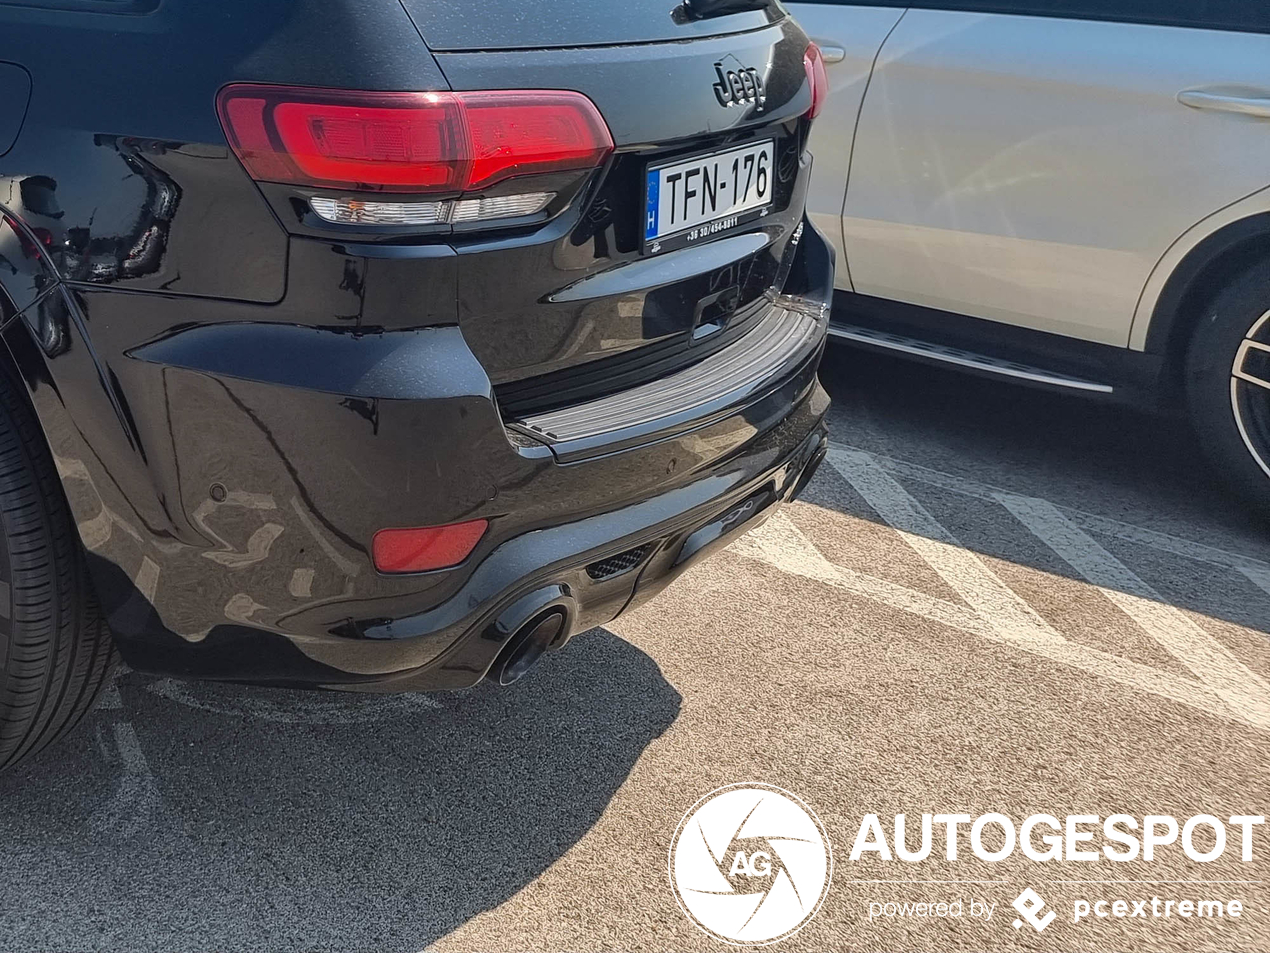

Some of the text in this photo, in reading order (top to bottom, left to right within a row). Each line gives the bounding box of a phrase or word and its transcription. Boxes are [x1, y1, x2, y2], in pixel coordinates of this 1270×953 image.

[712, 62, 766, 111] Jeep
[666, 150, 768, 225] TFN-176
[647, 211, 655, 230] H
